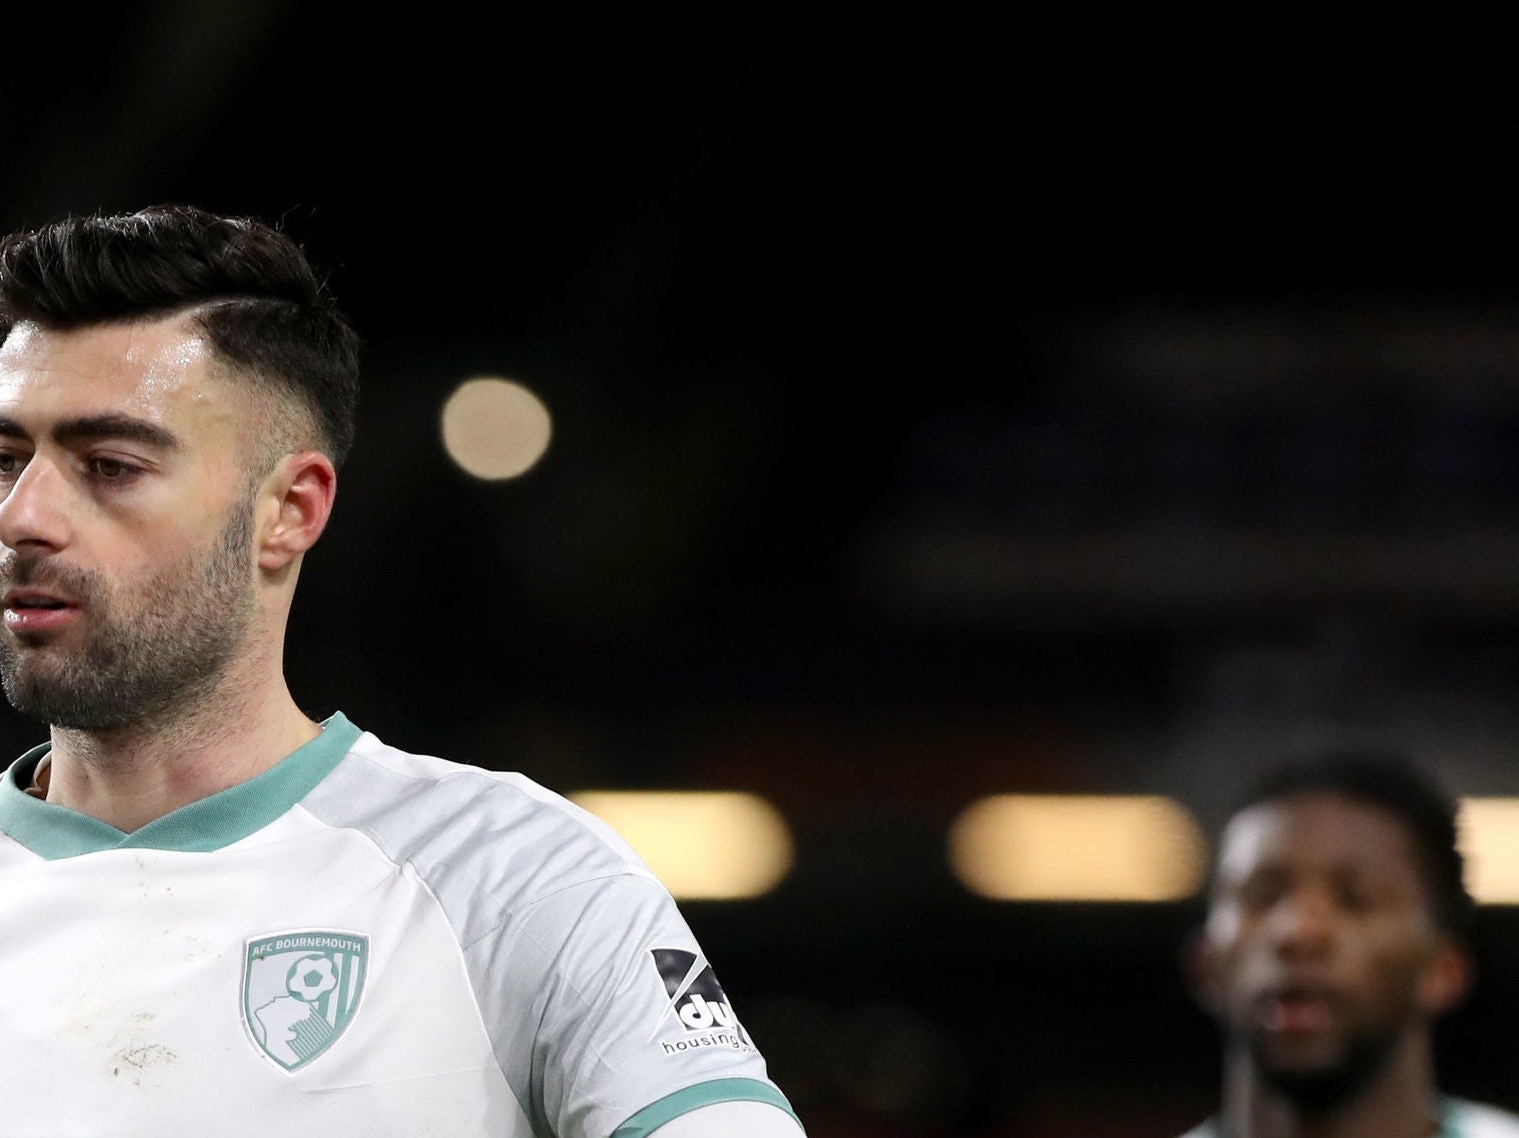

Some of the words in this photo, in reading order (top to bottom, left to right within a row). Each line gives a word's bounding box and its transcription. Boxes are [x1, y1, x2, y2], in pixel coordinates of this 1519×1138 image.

[252, 942, 274, 956] AFC
[276, 937, 362, 952] BOURNEMOUTH
[662, 1034, 740, 1055] housing
